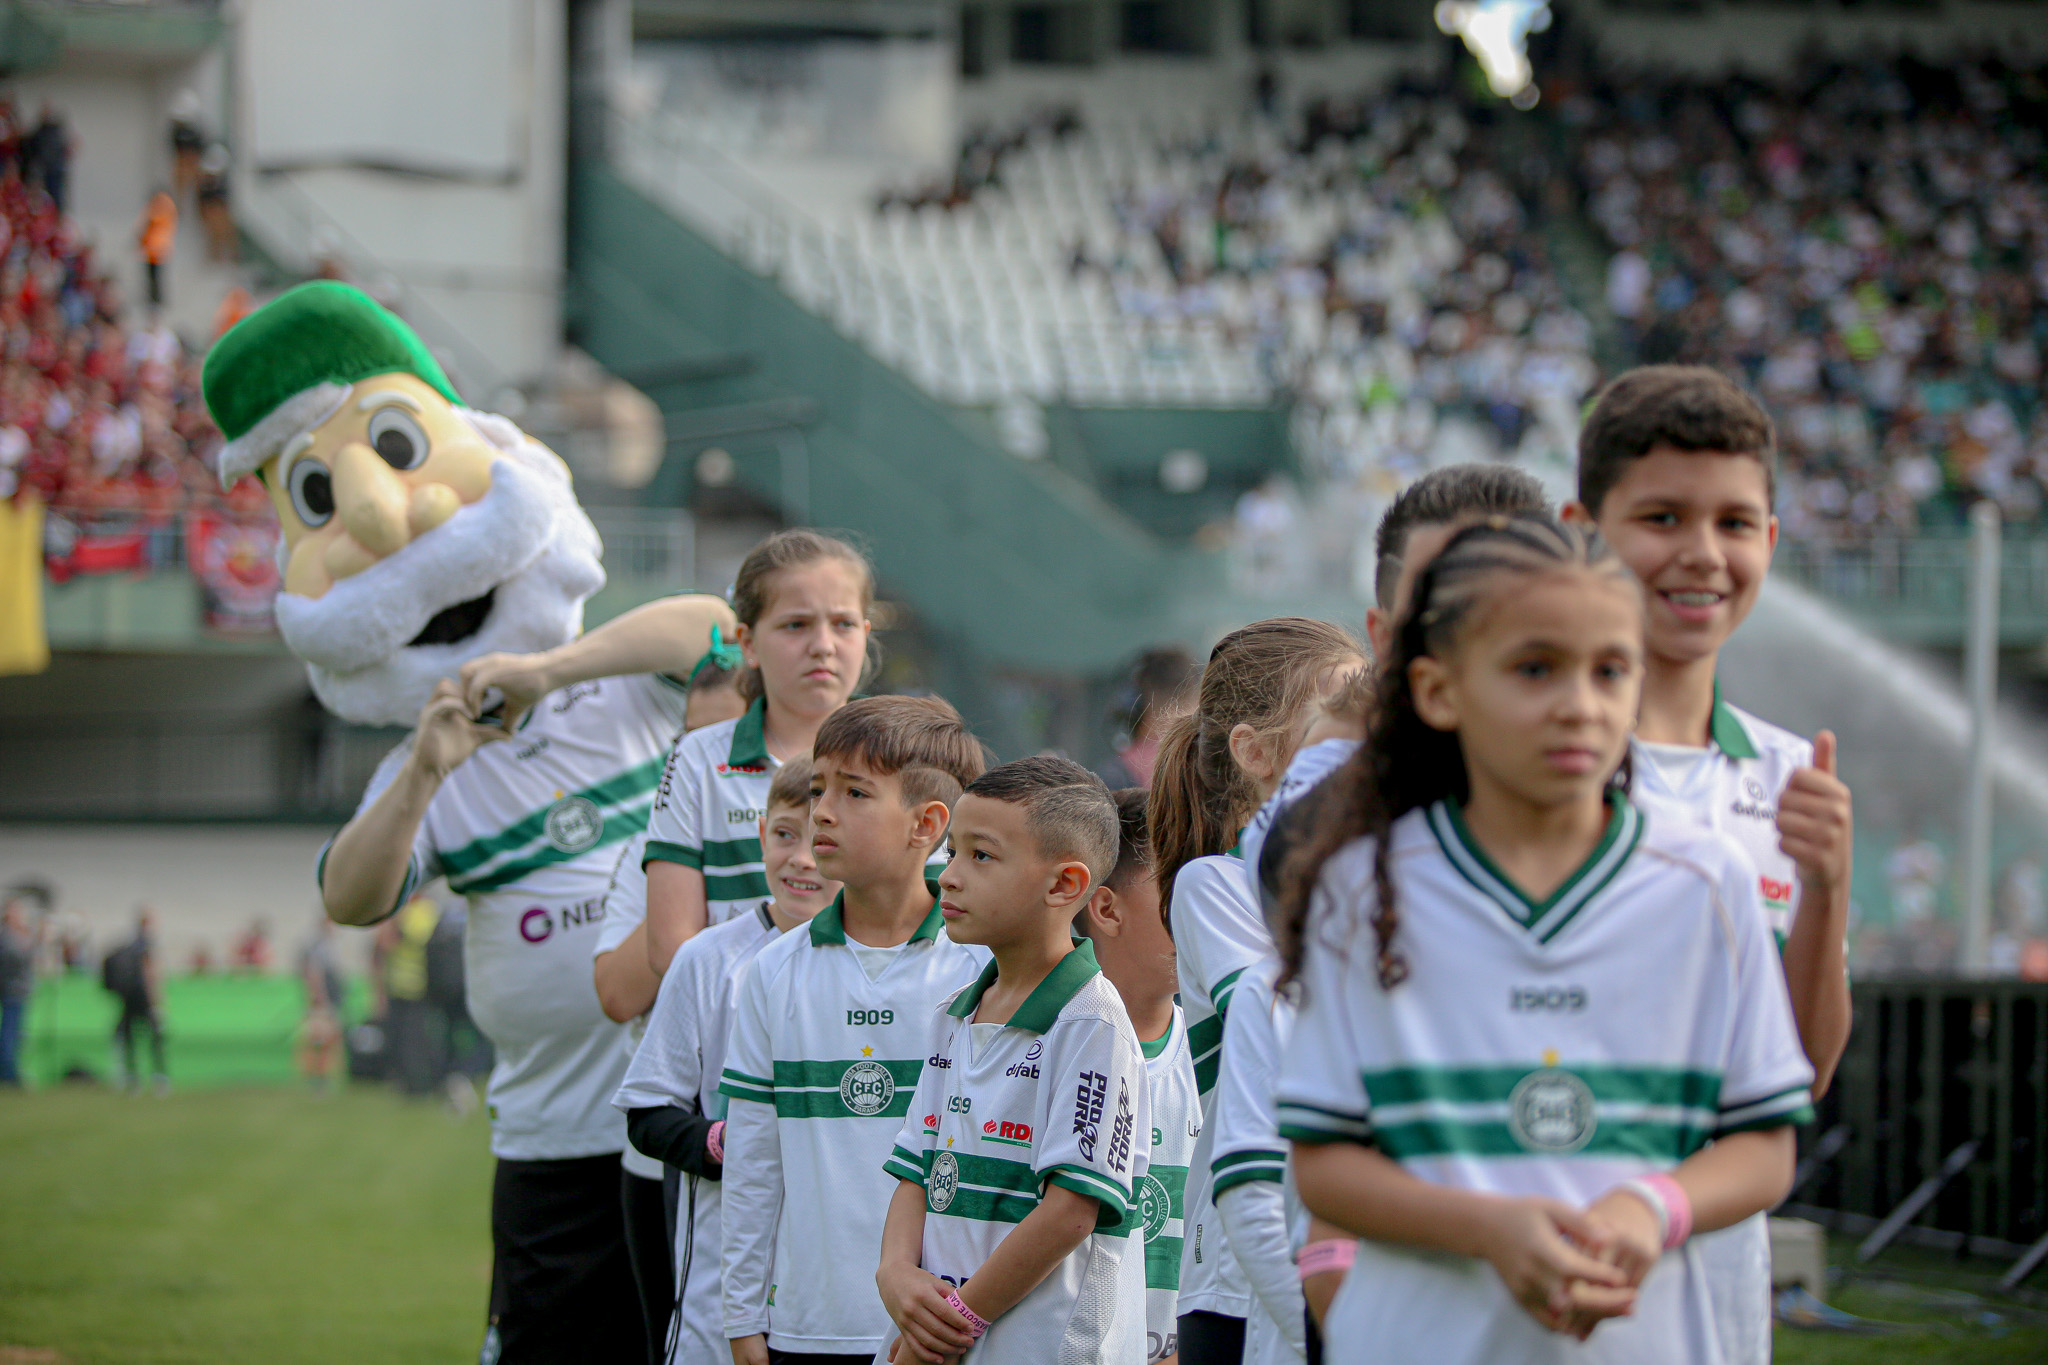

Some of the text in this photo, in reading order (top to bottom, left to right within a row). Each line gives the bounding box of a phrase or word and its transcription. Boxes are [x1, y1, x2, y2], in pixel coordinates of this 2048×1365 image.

[846, 1009, 895, 1026] 1909
[1509, 985, 1589, 1013] 1909
[853, 1081, 882, 1095] CFC
[1073, 1070, 1093, 1135] TORK
[1089, 1072, 1108, 1124] PRO
[1107, 1114, 1124, 1170] PRO
[1115, 1113, 1134, 1174] TORK
[934, 1174, 951, 1190] CFC
[1144, 1176, 1162, 1196] BALL
[1158, 1196, 1168, 1221] CLUB
